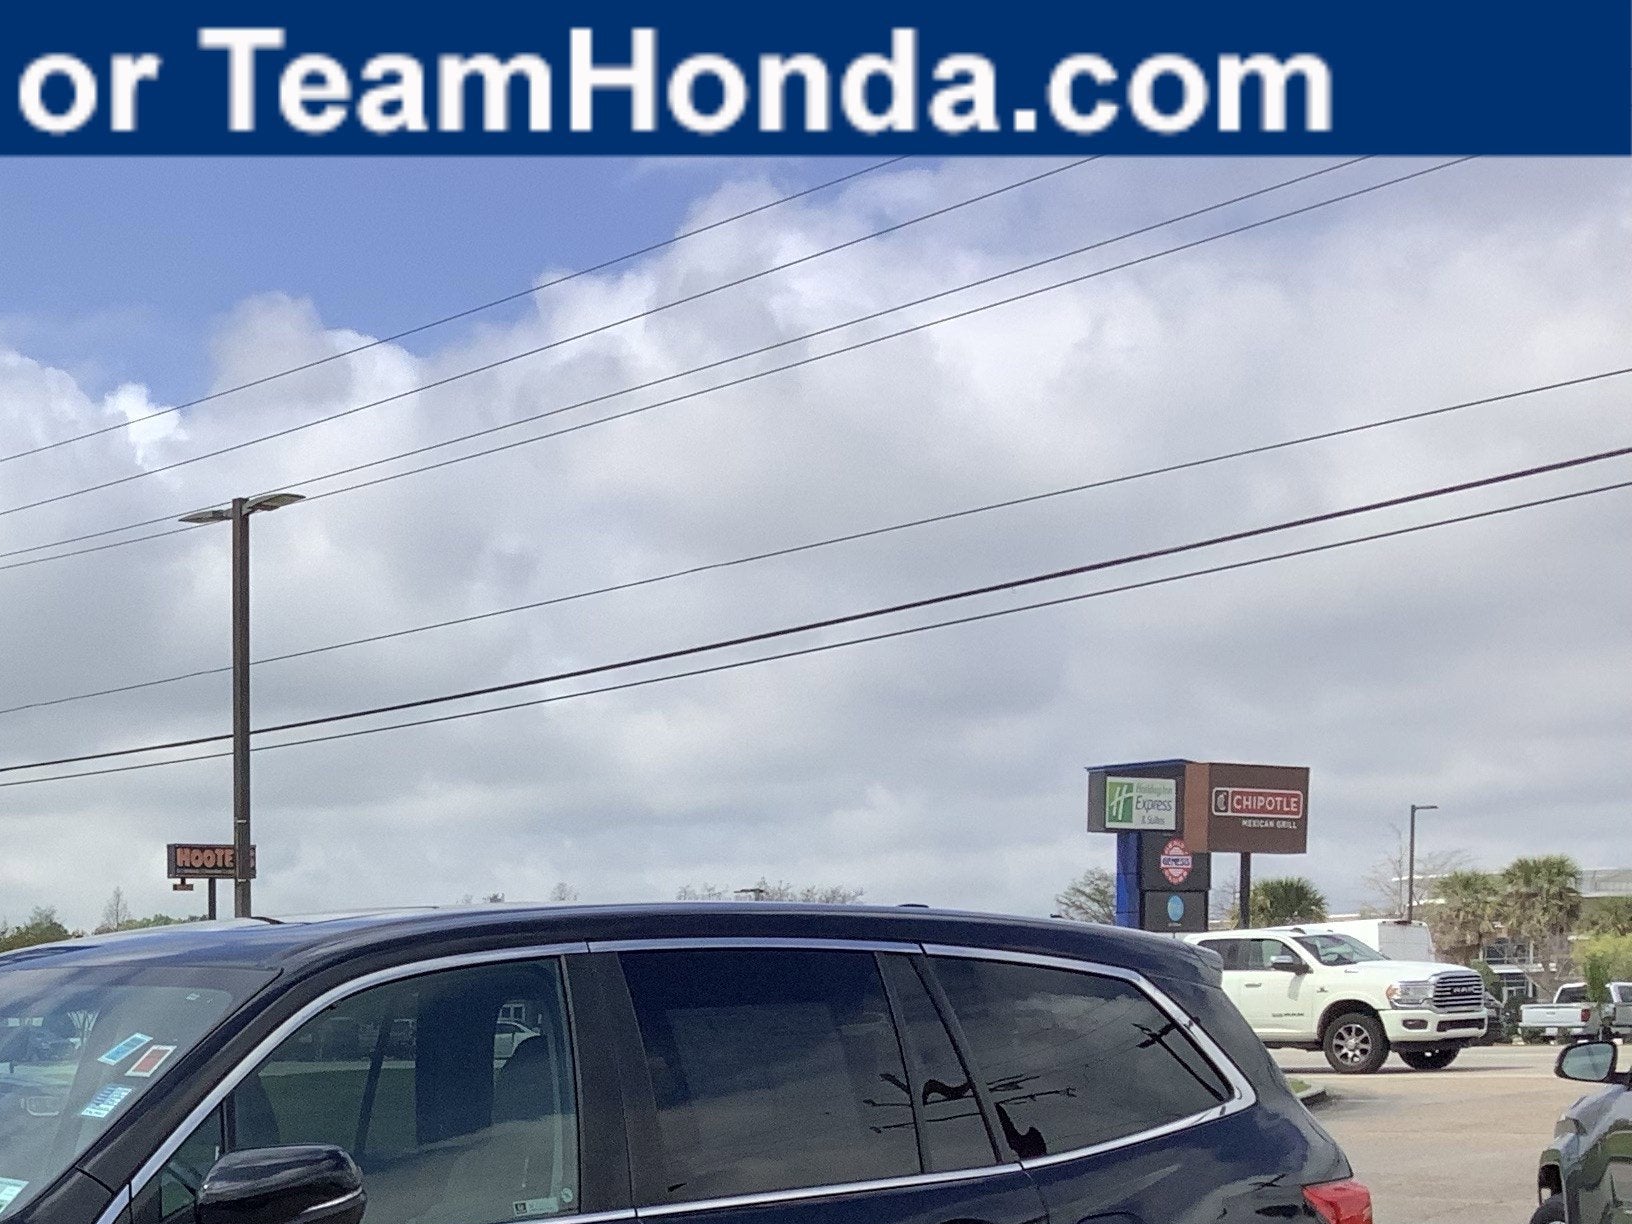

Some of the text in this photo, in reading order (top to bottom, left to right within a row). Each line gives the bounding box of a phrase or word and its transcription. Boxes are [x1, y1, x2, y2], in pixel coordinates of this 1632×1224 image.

[1135, 794, 1173, 813] Express
[1232, 795, 1299, 812] CHIPOTLE
[1242, 819, 1298, 829] MEXICAN GRILL
[176, 847, 255, 868] HOOTE
